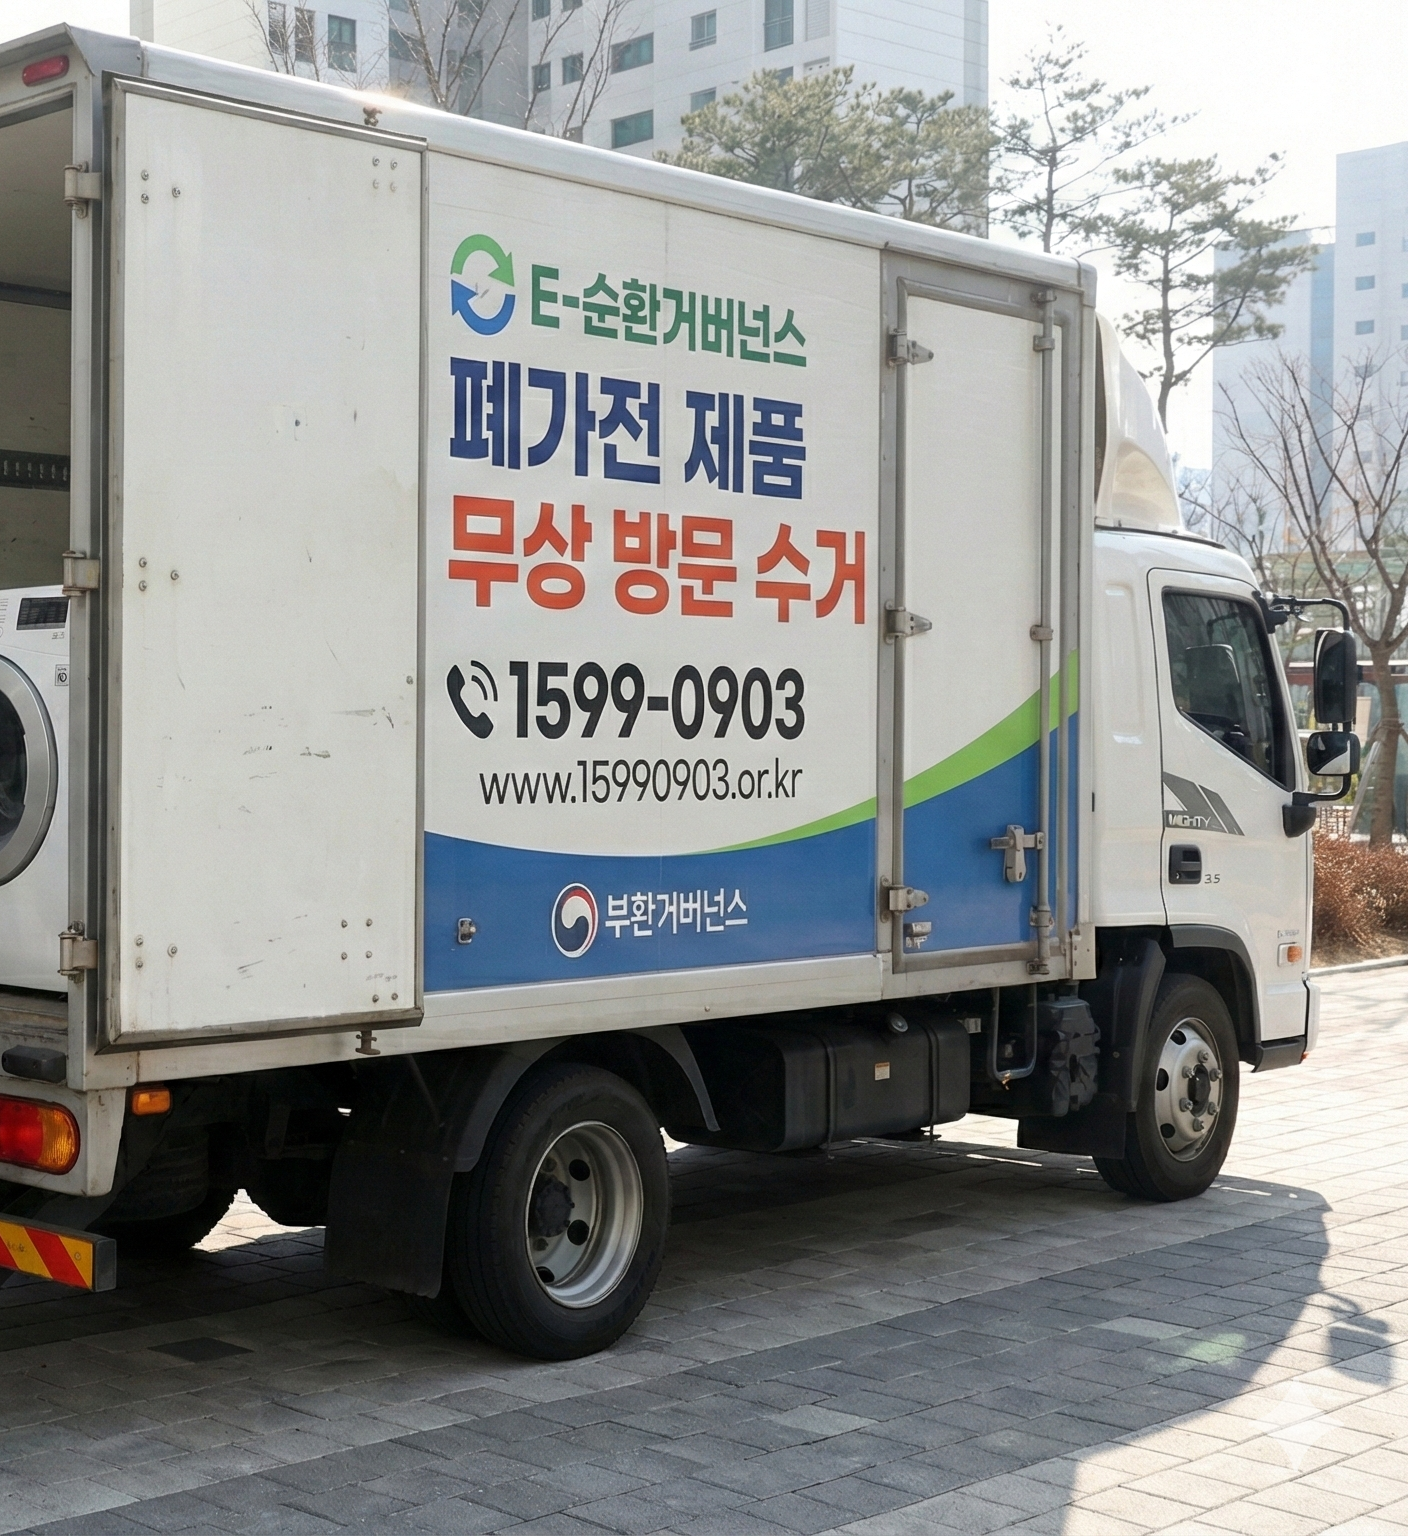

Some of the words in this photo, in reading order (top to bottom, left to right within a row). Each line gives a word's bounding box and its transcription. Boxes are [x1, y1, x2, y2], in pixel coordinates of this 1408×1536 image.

[531, 265, 807, 367] E-순환거버넌스
[450, 356, 661, 485] 폐가전
[684, 390, 806, 500] 제품
[447, 494, 593, 611] 무상
[612, 508, 738, 618] 방문
[755, 523, 867, 625] 수거
[508, 659, 806, 741] 1599-0903
[478, 756, 804, 806] www.15990903.or.kr
[604, 887, 749, 939] 부환거버넌스
